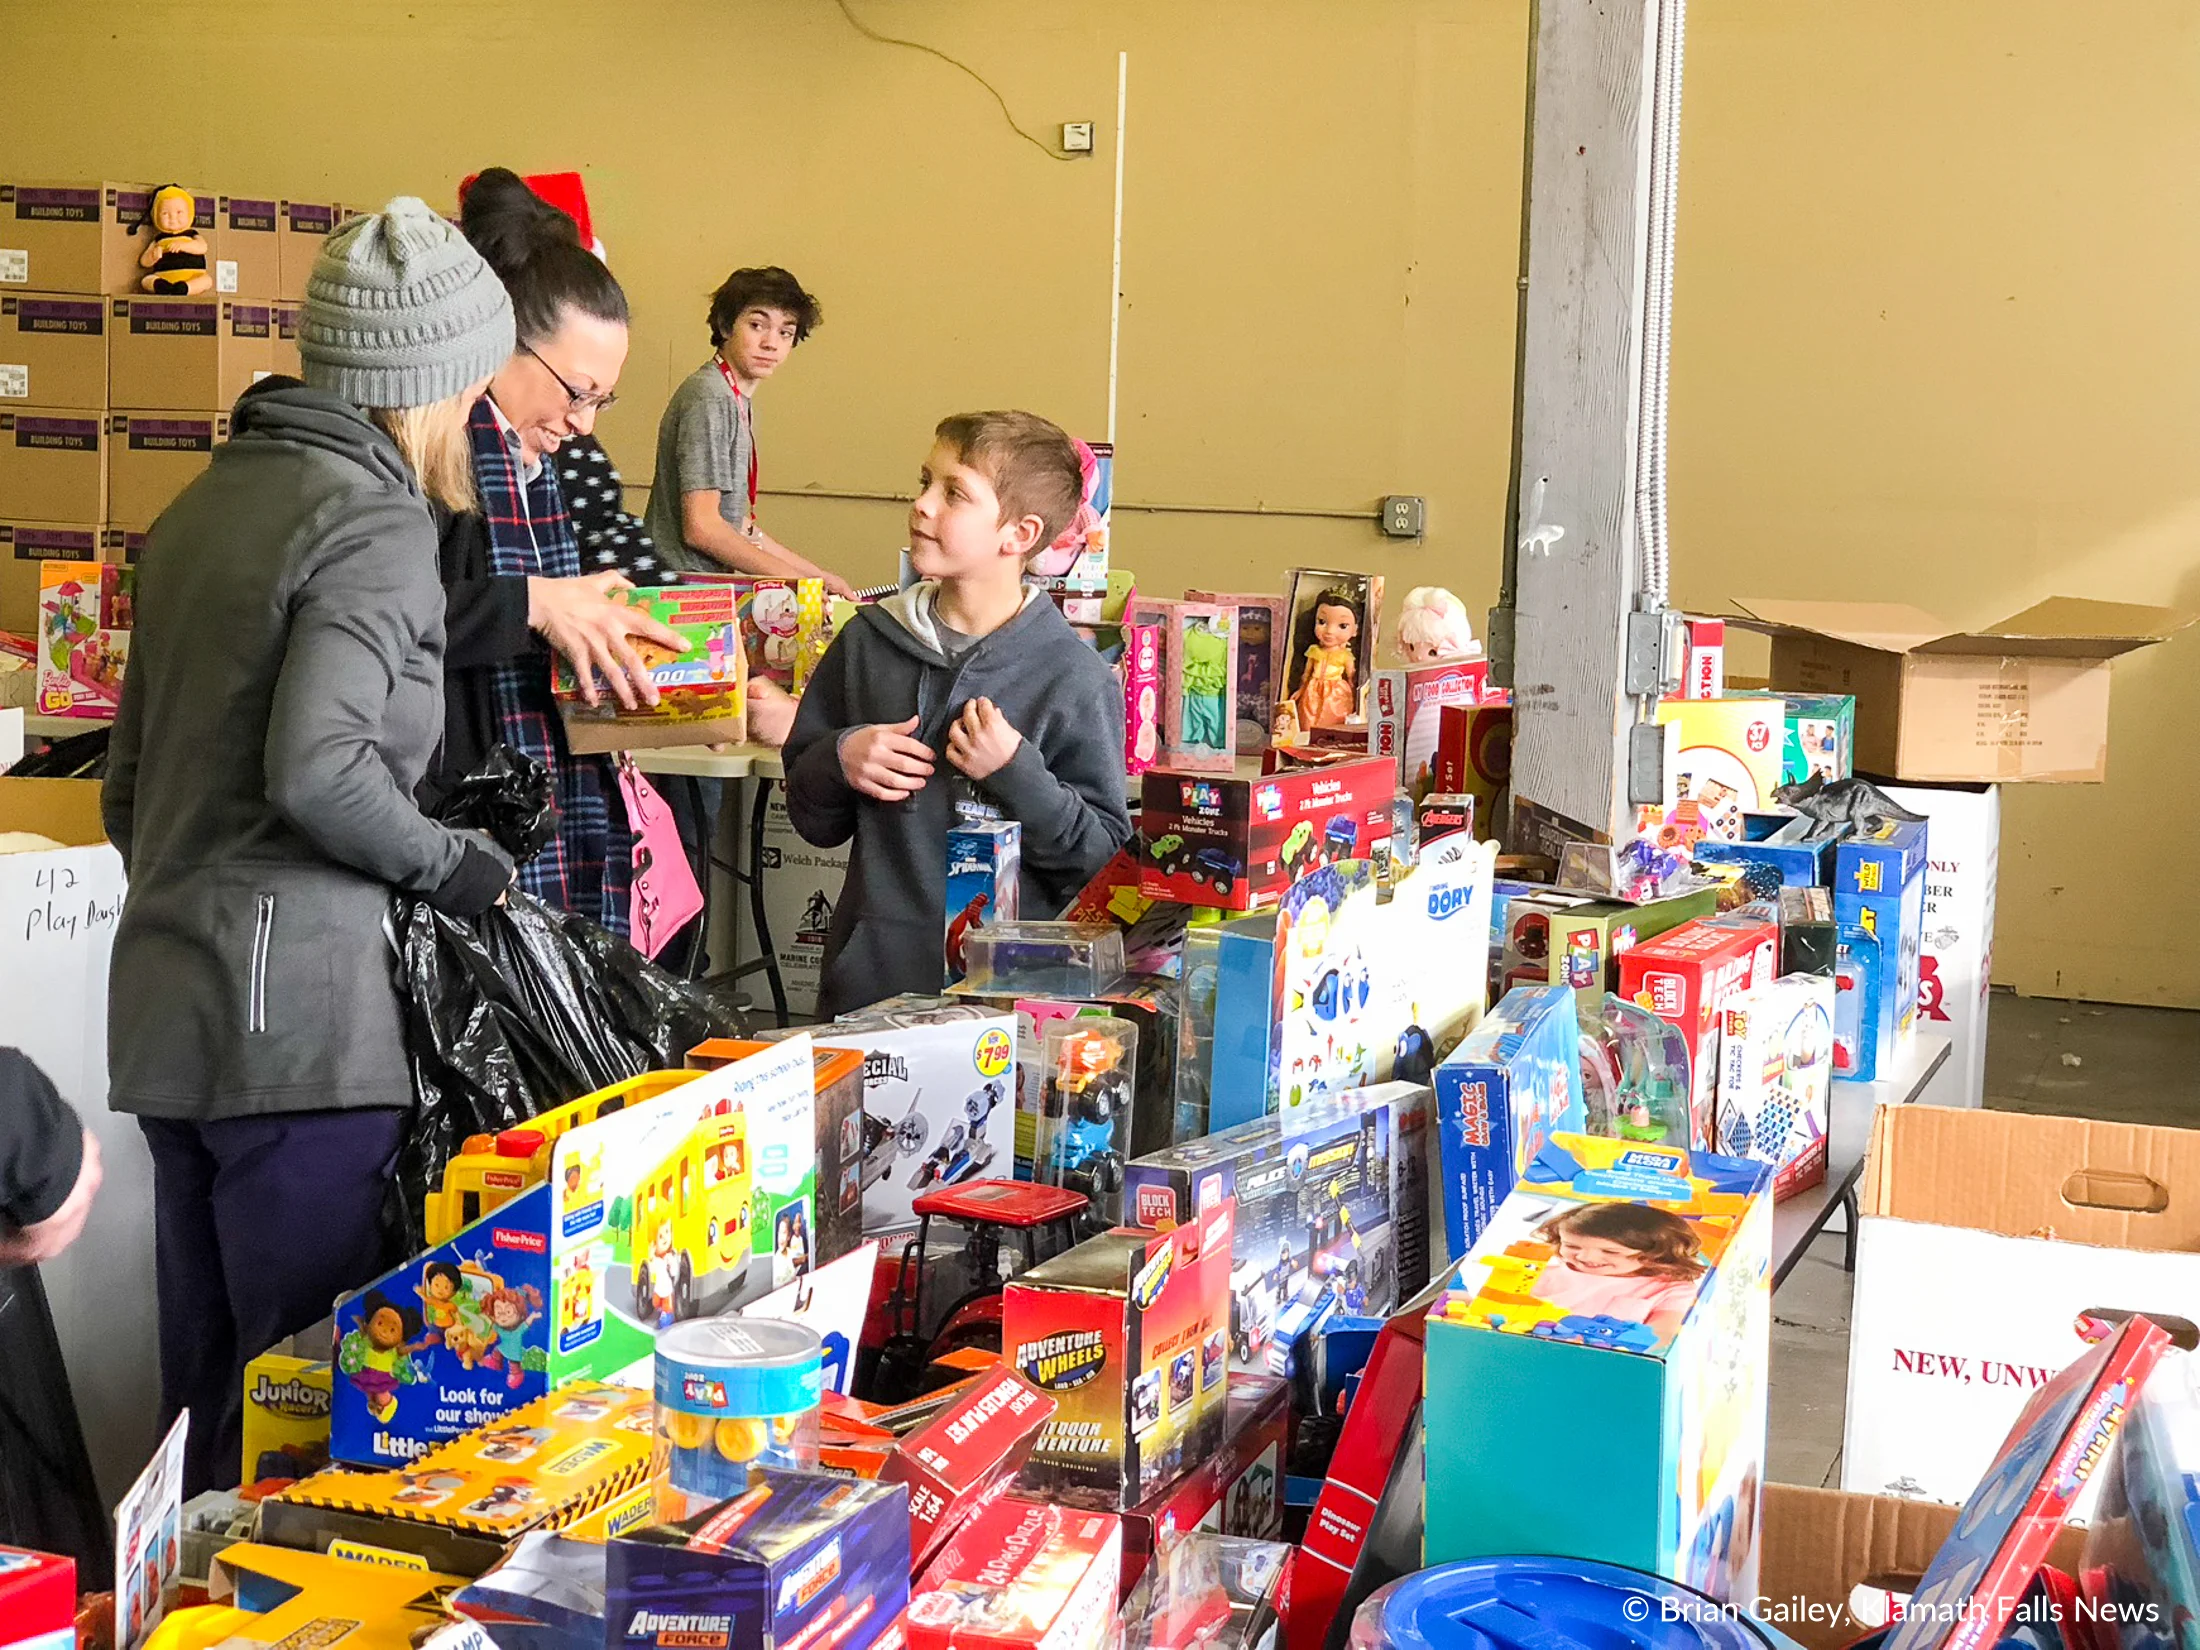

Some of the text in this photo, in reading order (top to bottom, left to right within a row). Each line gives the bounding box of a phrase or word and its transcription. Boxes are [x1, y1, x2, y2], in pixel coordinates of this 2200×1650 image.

[31, 206, 84, 218] BUILDING TOYS
[33, 319, 88, 331] BUILDING TOYS
[145, 321, 200, 332] BUILDING TOYS
[30, 435, 83, 447] BUILDING TOYS
[144, 437, 197, 448] BUILDING TOYS
[29, 548, 80, 559] BUILDING TOYS
[45, 692, 73, 709] GO
[1750, 722, 1766, 741] 37
[1182, 786, 1220, 805] PLAY
[1312, 779, 1342, 795] Vehicles
[1182, 815, 1215, 827] Vehicles
[1198, 806, 1220, 816] ZONE
[1182, 825, 1207, 834] Monster
[1208, 828, 1228, 837] Trucks
[783, 853, 812, 867] Welch
[36, 868, 79, 894] 42
[1863, 863, 1871, 887] WILD
[1428, 885, 1474, 914] DORY
[26, 901, 77, 941] Play
[1561, 955, 1570, 986] ZONE
[1574, 933, 1592, 985] PLAY
[1653, 978, 1664, 1010] TECH
[1663, 978, 1677, 1010] BLOCK
[1734, 1010, 1748, 1040] TOY
[1735, 1044, 1744, 1084] CHECKERS
[1461, 1082, 1481, 1145] MAGIC
[1246, 1165, 1287, 1190] POLICE
[1141, 1193, 1170, 1209] BLOCK
[1141, 1206, 1172, 1217] TECH
[495, 1230, 543, 1247] Fisher-Price
[1016, 1329, 1103, 1370] ADVENTURE
[1151, 1335, 1180, 1361] COLLECT
[1038, 1343, 1104, 1384] WHEELS
[1893, 1348, 1971, 1385] NEW,
[440, 1385, 503, 1405] Look for
[683, 1381, 726, 1403] PLAY
[1054, 1380, 1068, 1390] LAND
[1072, 1376, 1084, 1388] SEA
[436, 1408, 460, 1423] our
[946, 1375, 1023, 1444] VEHICLES PLAY SET
[373, 1431, 428, 1458] Little
[2074, 1402, 2124, 1481] My First
[555, 1440, 608, 1475] WADER
[908, 1484, 931, 1516] SCALE
[919, 1493, 945, 1524] 1:64
[606, 1497, 653, 1536] WADER
[1320, 1506, 1362, 1533] Dinosaur
[1318, 1518, 1356, 1543] Play Set
[628, 1610, 732, 1634] ADVENTURE
